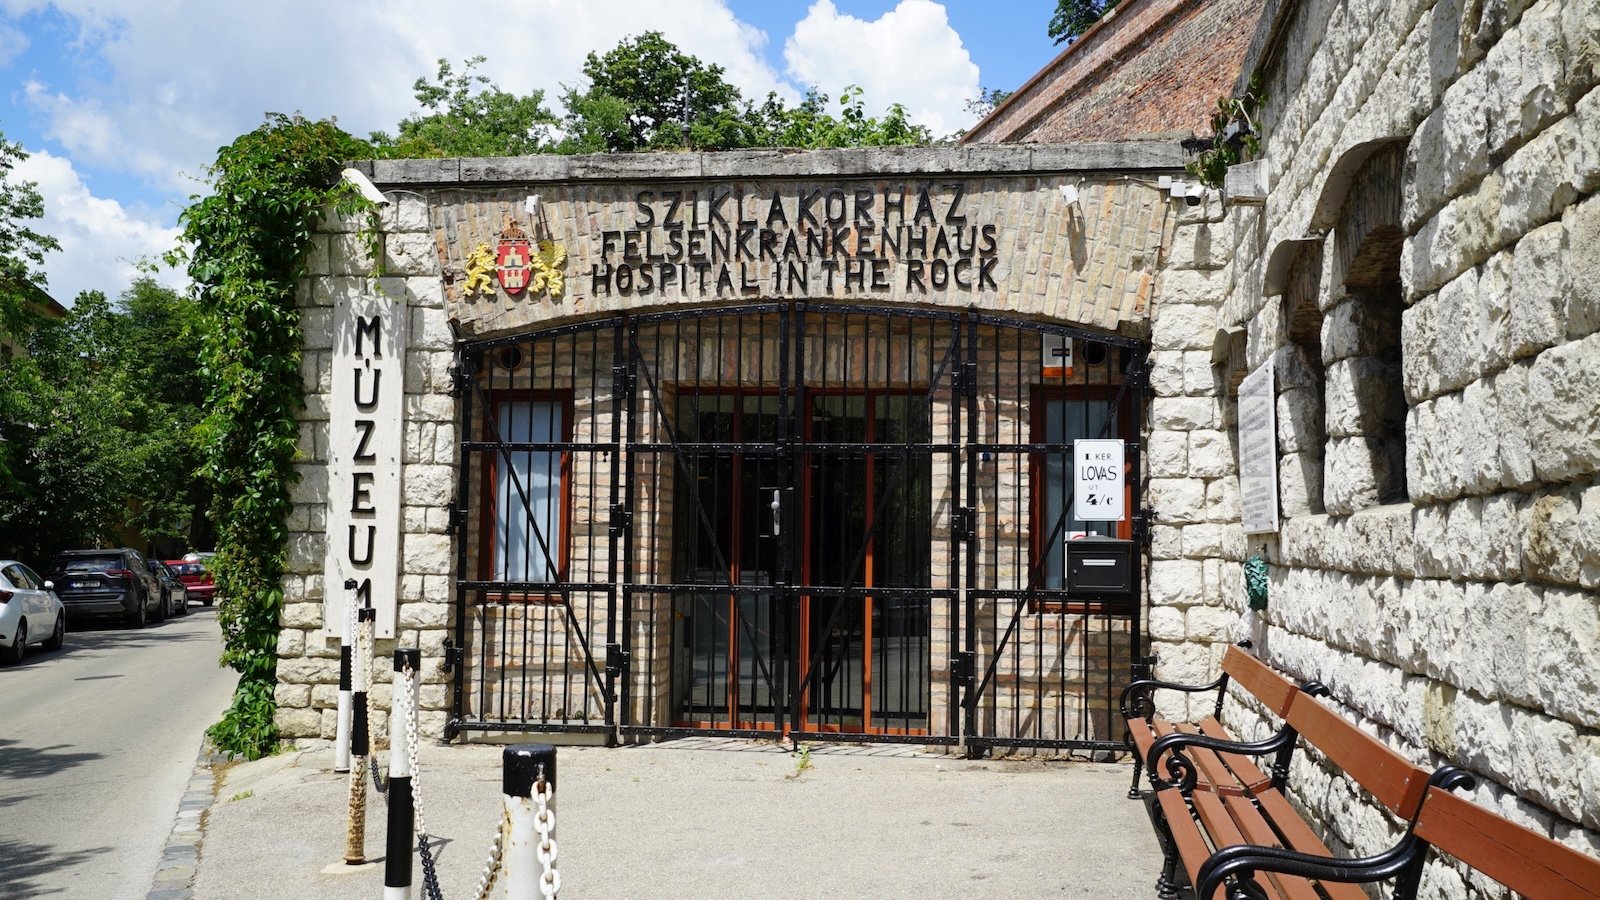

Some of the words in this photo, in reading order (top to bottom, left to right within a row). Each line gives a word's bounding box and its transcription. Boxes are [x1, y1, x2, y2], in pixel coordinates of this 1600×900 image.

[601, 225, 996, 262] FELSENKRANKENHAUS
[591, 262, 760, 296] HOSPITAL
[774, 261, 808, 295] IN
[821, 258, 890, 293] THE
[906, 257, 998, 293] ROCK
[1081, 465, 1117, 481] LOVAS
